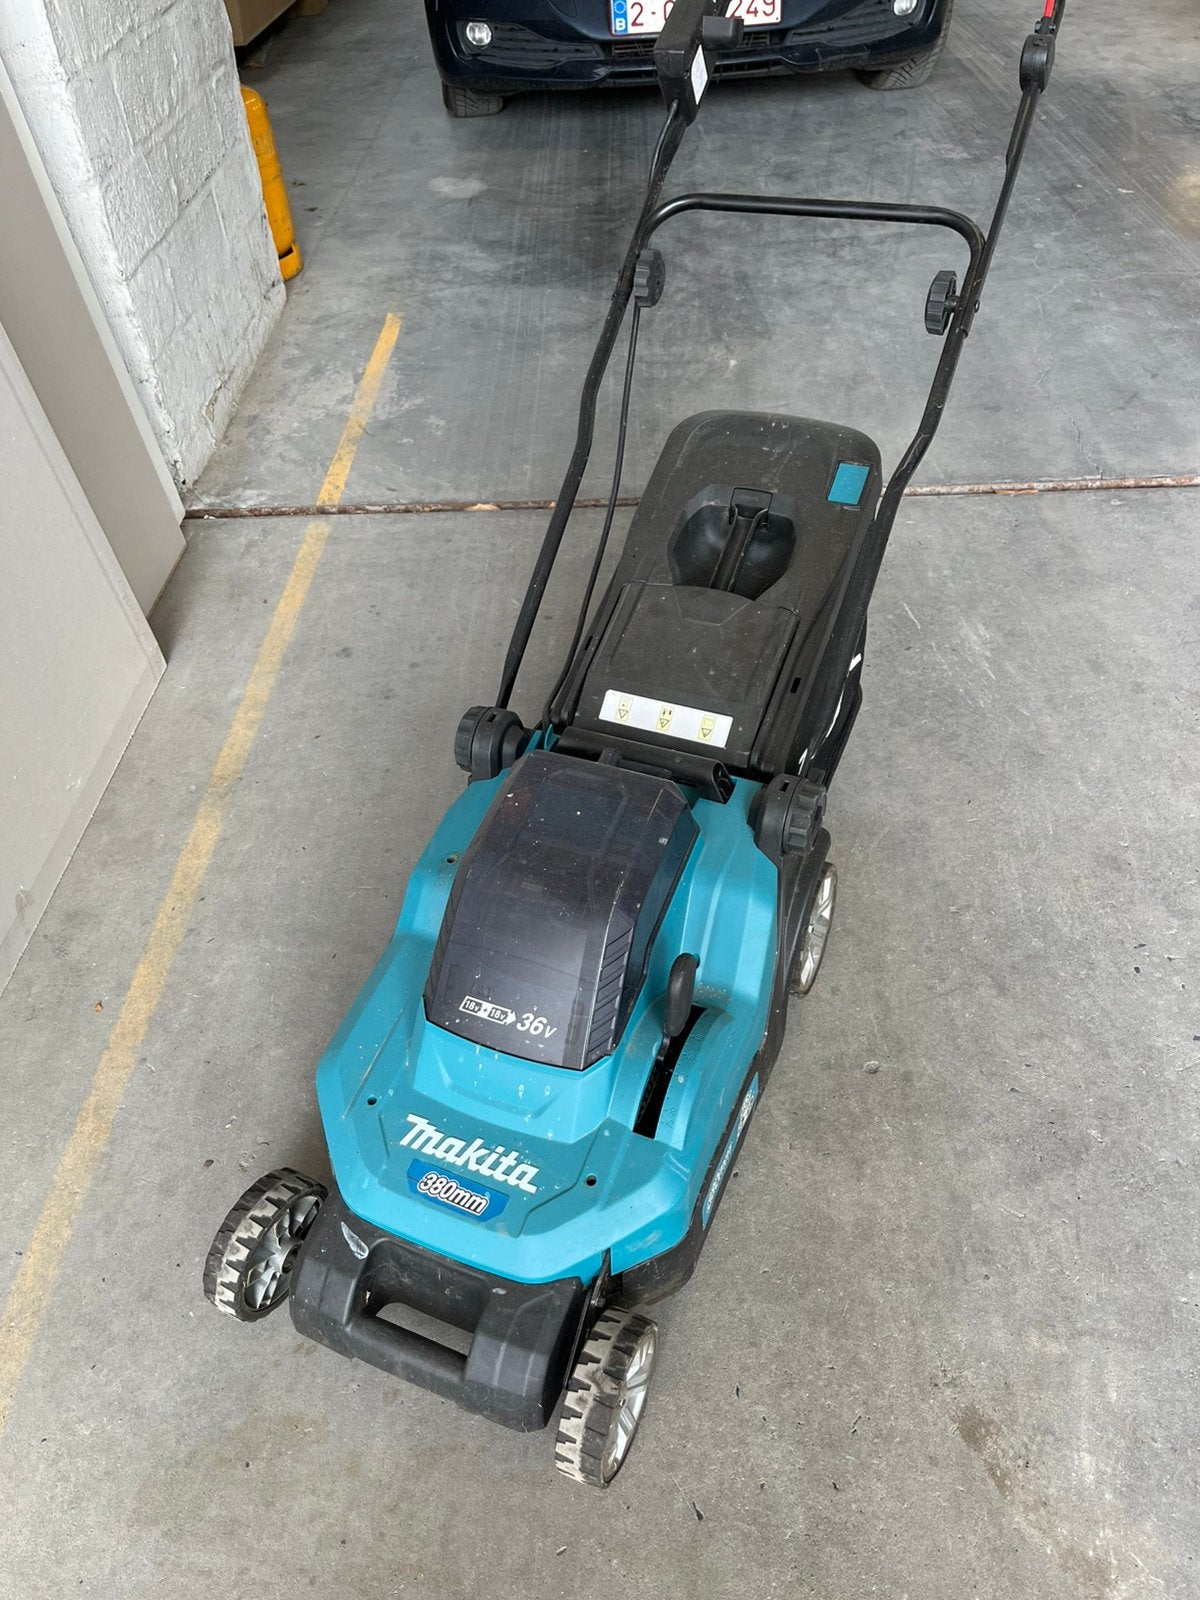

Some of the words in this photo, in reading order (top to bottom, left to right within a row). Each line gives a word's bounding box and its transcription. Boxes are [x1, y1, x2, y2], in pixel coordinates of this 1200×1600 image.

[729, 0, 776, 19] 249
[615, 18, 626, 31] B
[418, 1172, 489, 1215] 380mm
